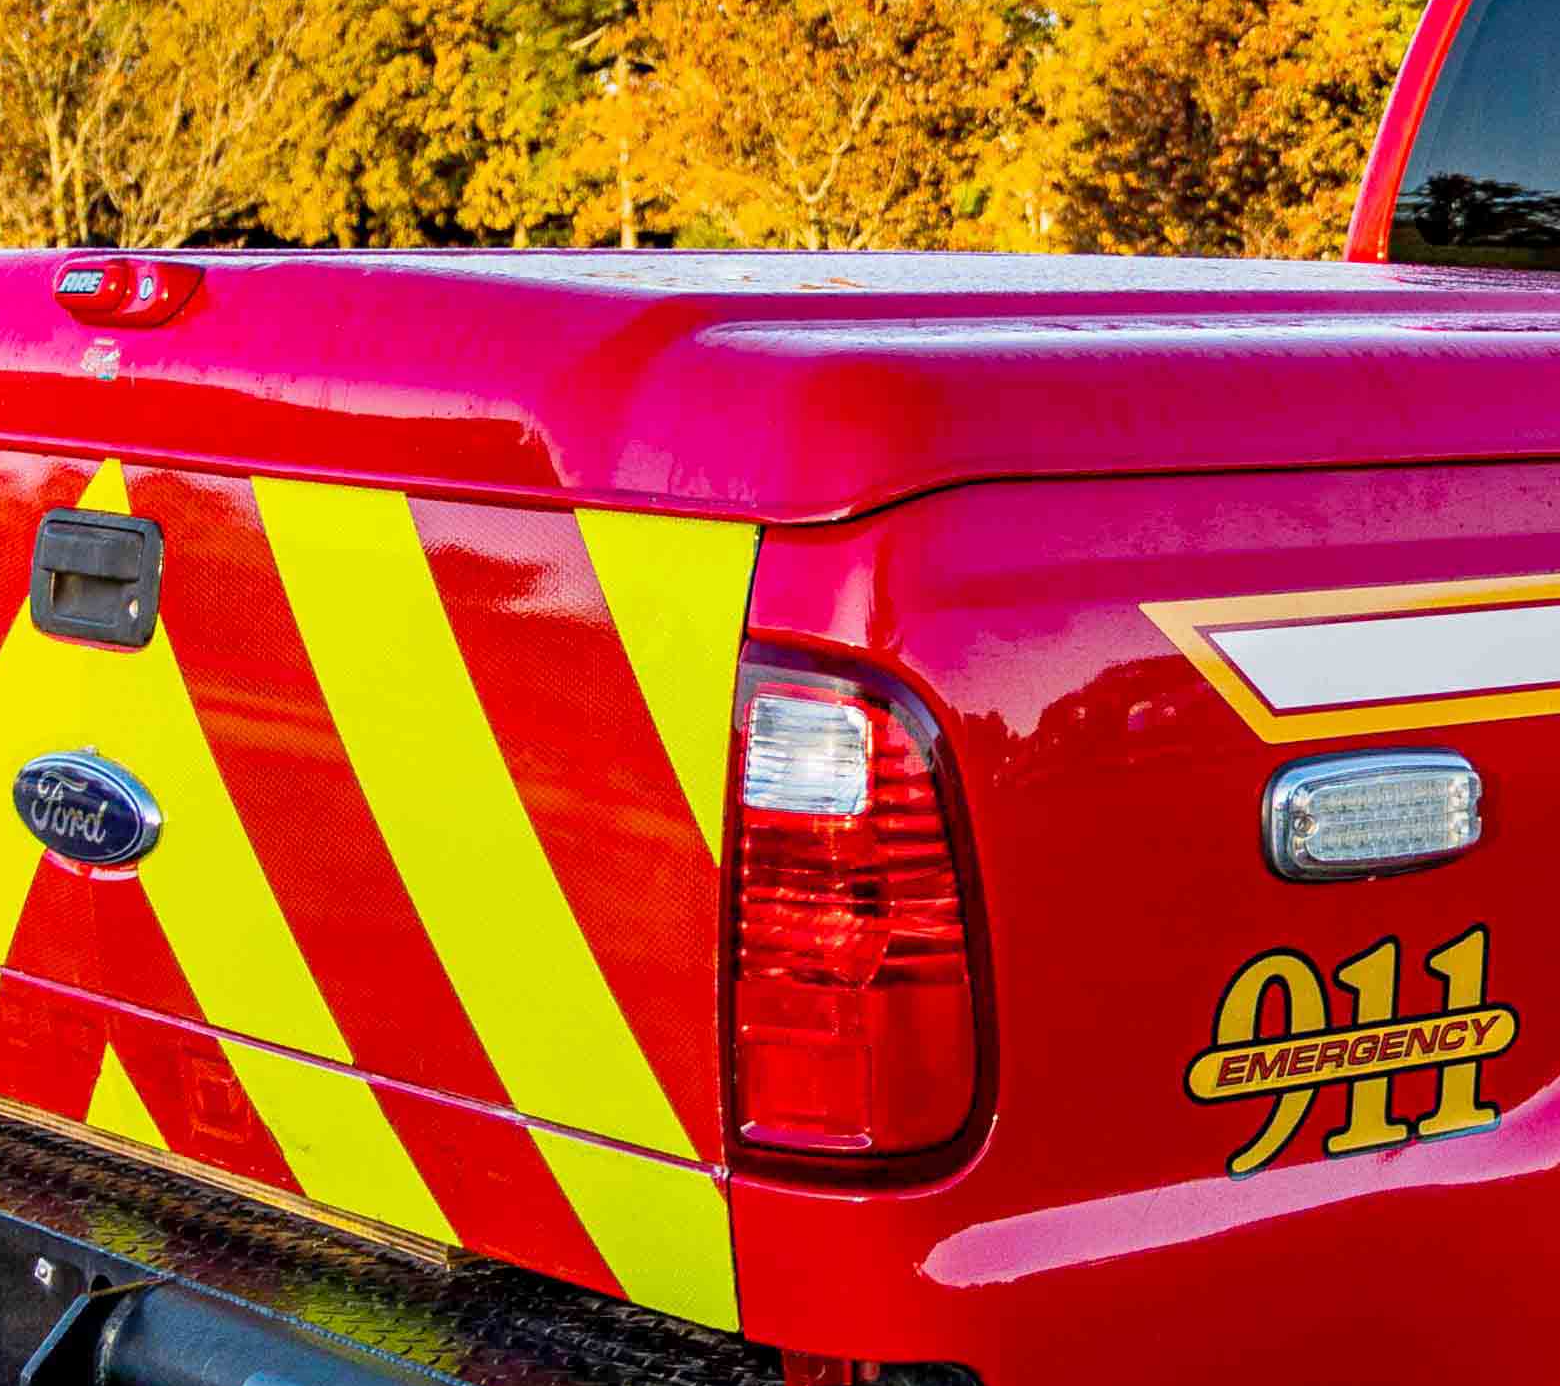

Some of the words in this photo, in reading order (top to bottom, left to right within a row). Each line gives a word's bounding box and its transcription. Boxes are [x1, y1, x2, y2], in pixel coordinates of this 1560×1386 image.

[31, 771, 109, 844] Ford
[1210, 923, 1502, 1181] 911
[1216, 1015, 1500, 1088] EMERGENCY
